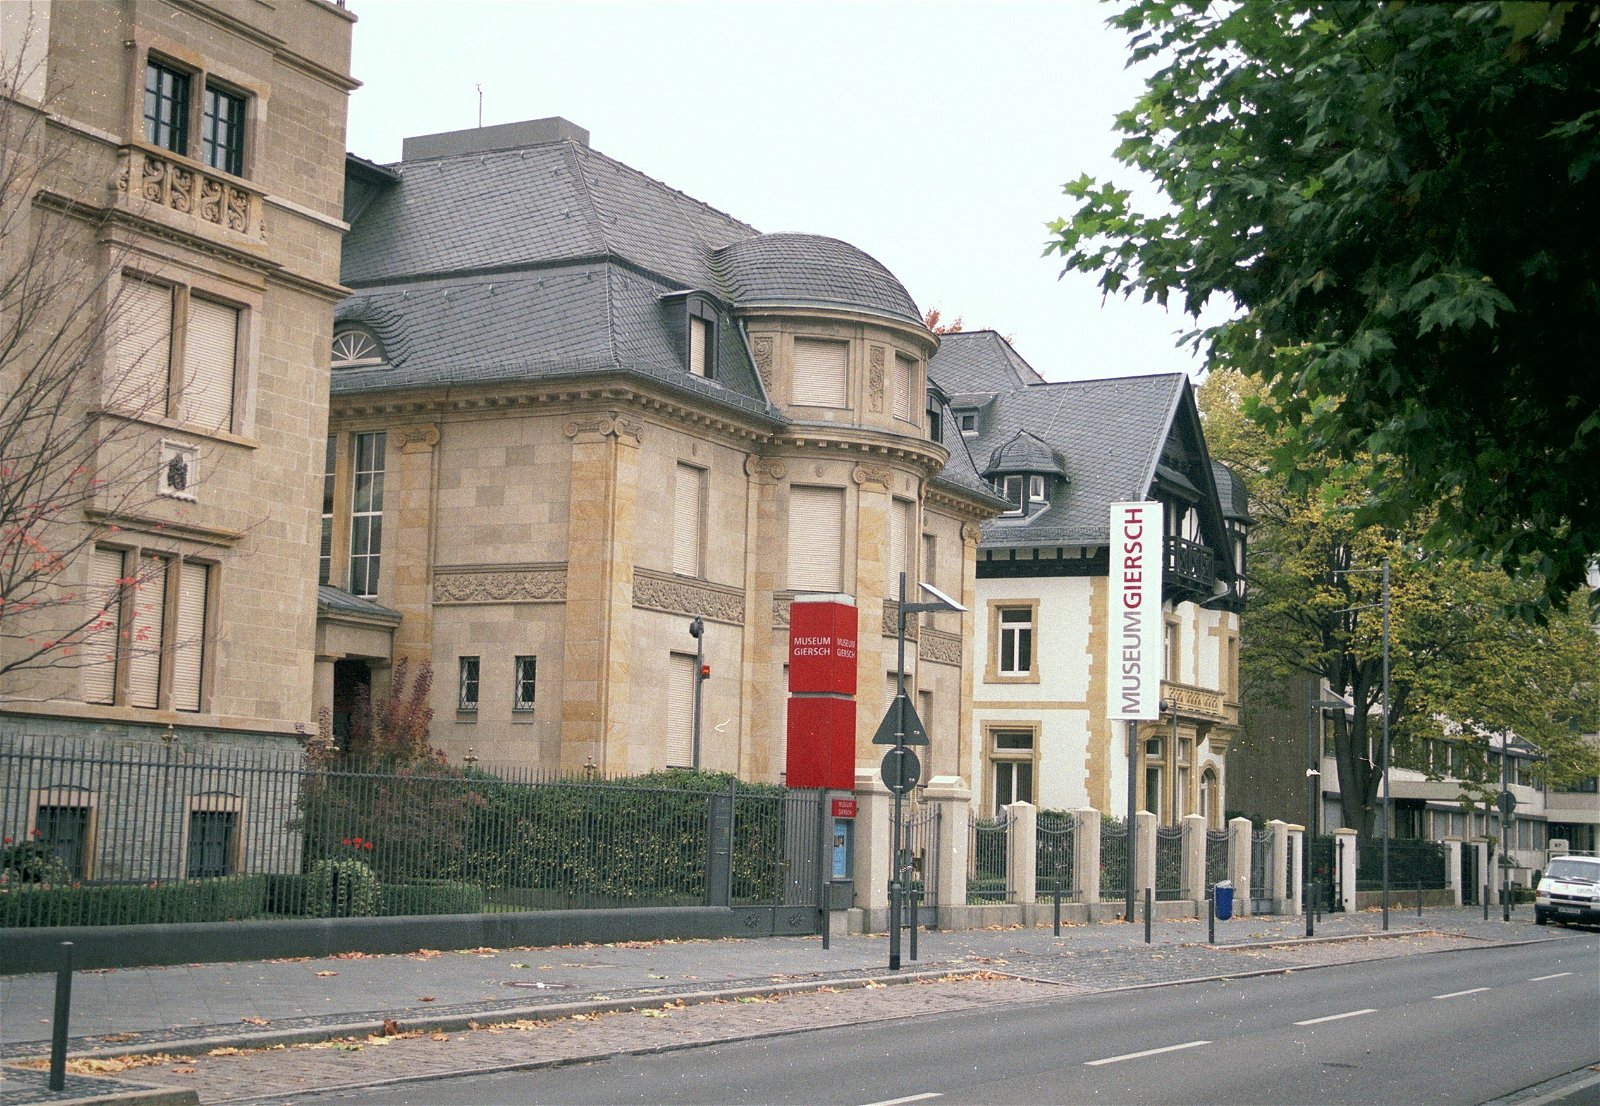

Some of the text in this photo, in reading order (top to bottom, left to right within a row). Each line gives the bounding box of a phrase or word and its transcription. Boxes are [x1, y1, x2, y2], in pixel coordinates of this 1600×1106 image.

[794, 637, 831, 645] MUSEUM
[837, 638, 856, 648] MUSEUM
[794, 648, 831, 656] GIERSCH
[836, 648, 856, 659] GIERSCH
